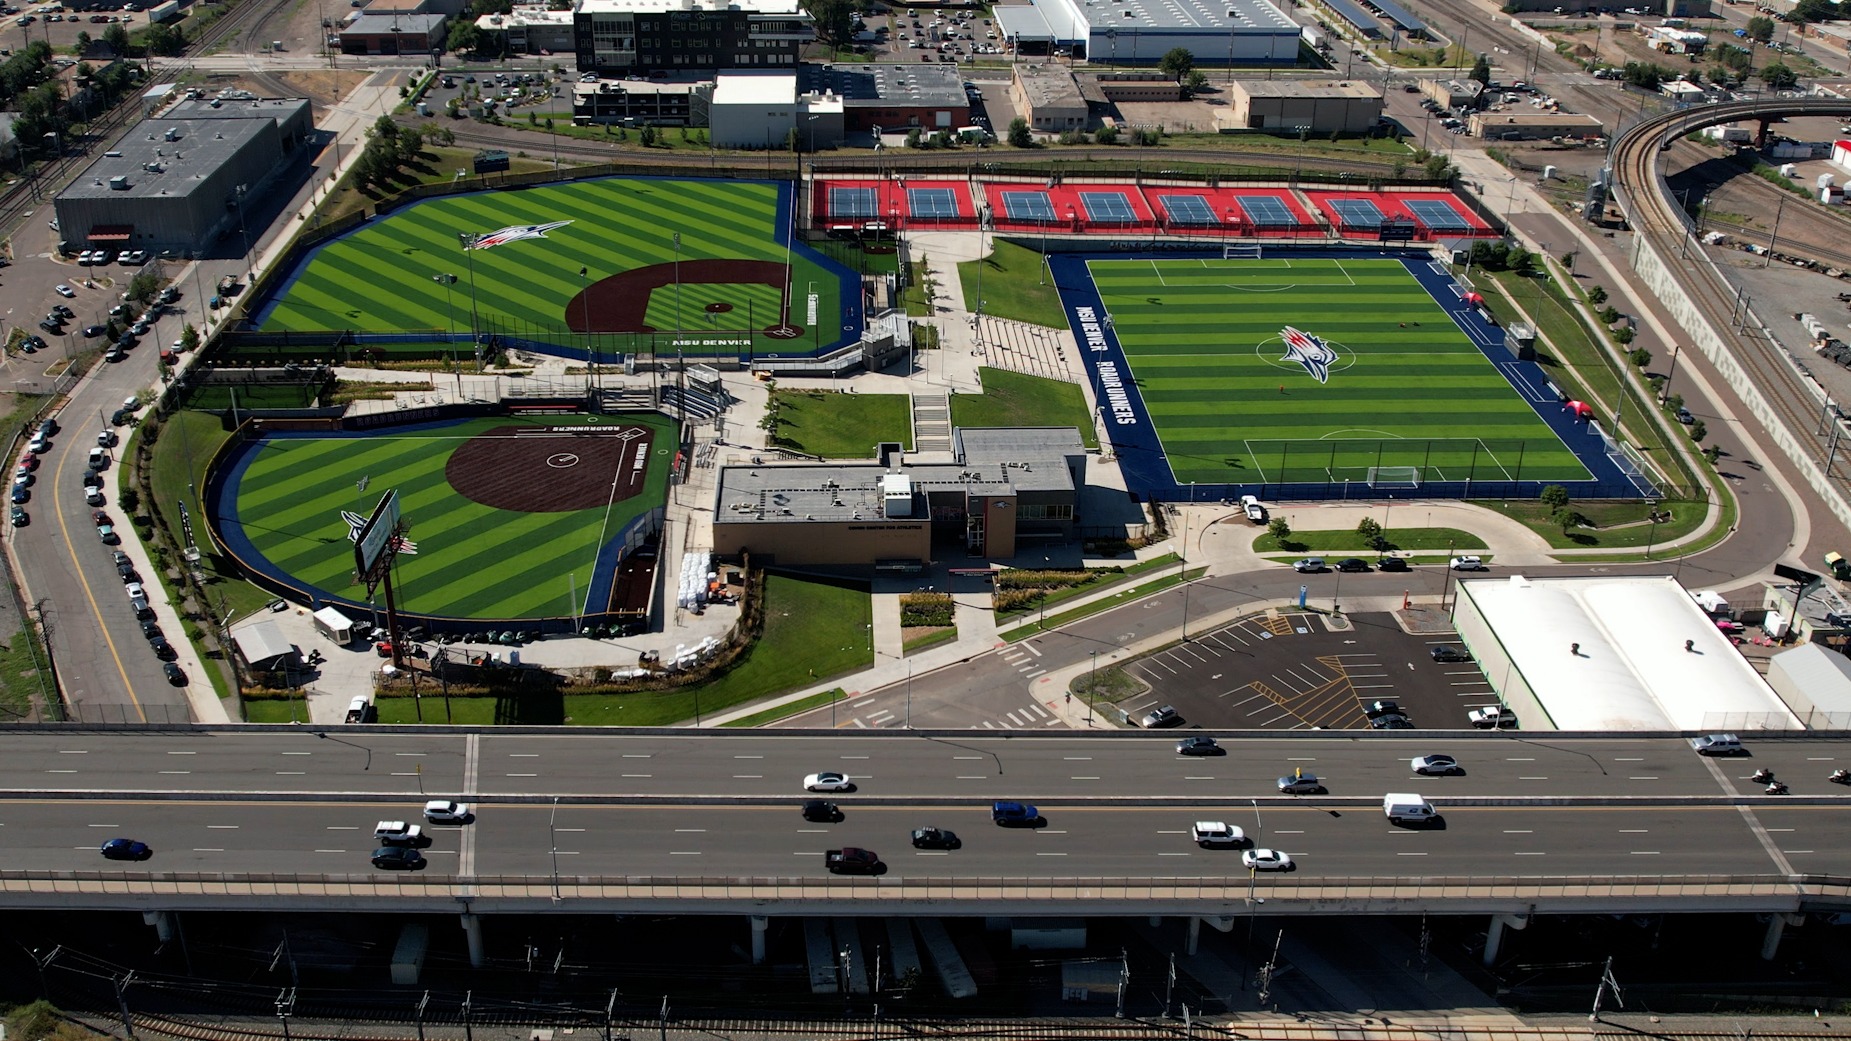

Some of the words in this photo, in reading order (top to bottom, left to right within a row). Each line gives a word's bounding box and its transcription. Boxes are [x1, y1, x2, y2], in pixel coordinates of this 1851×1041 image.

[1075, 306, 1098, 322] MSU
[1081, 322, 1109, 352] DENVER
[1096, 360, 1137, 425] ROADRUNNERS
[356, 408, 439, 426] ROADRUNNERS
